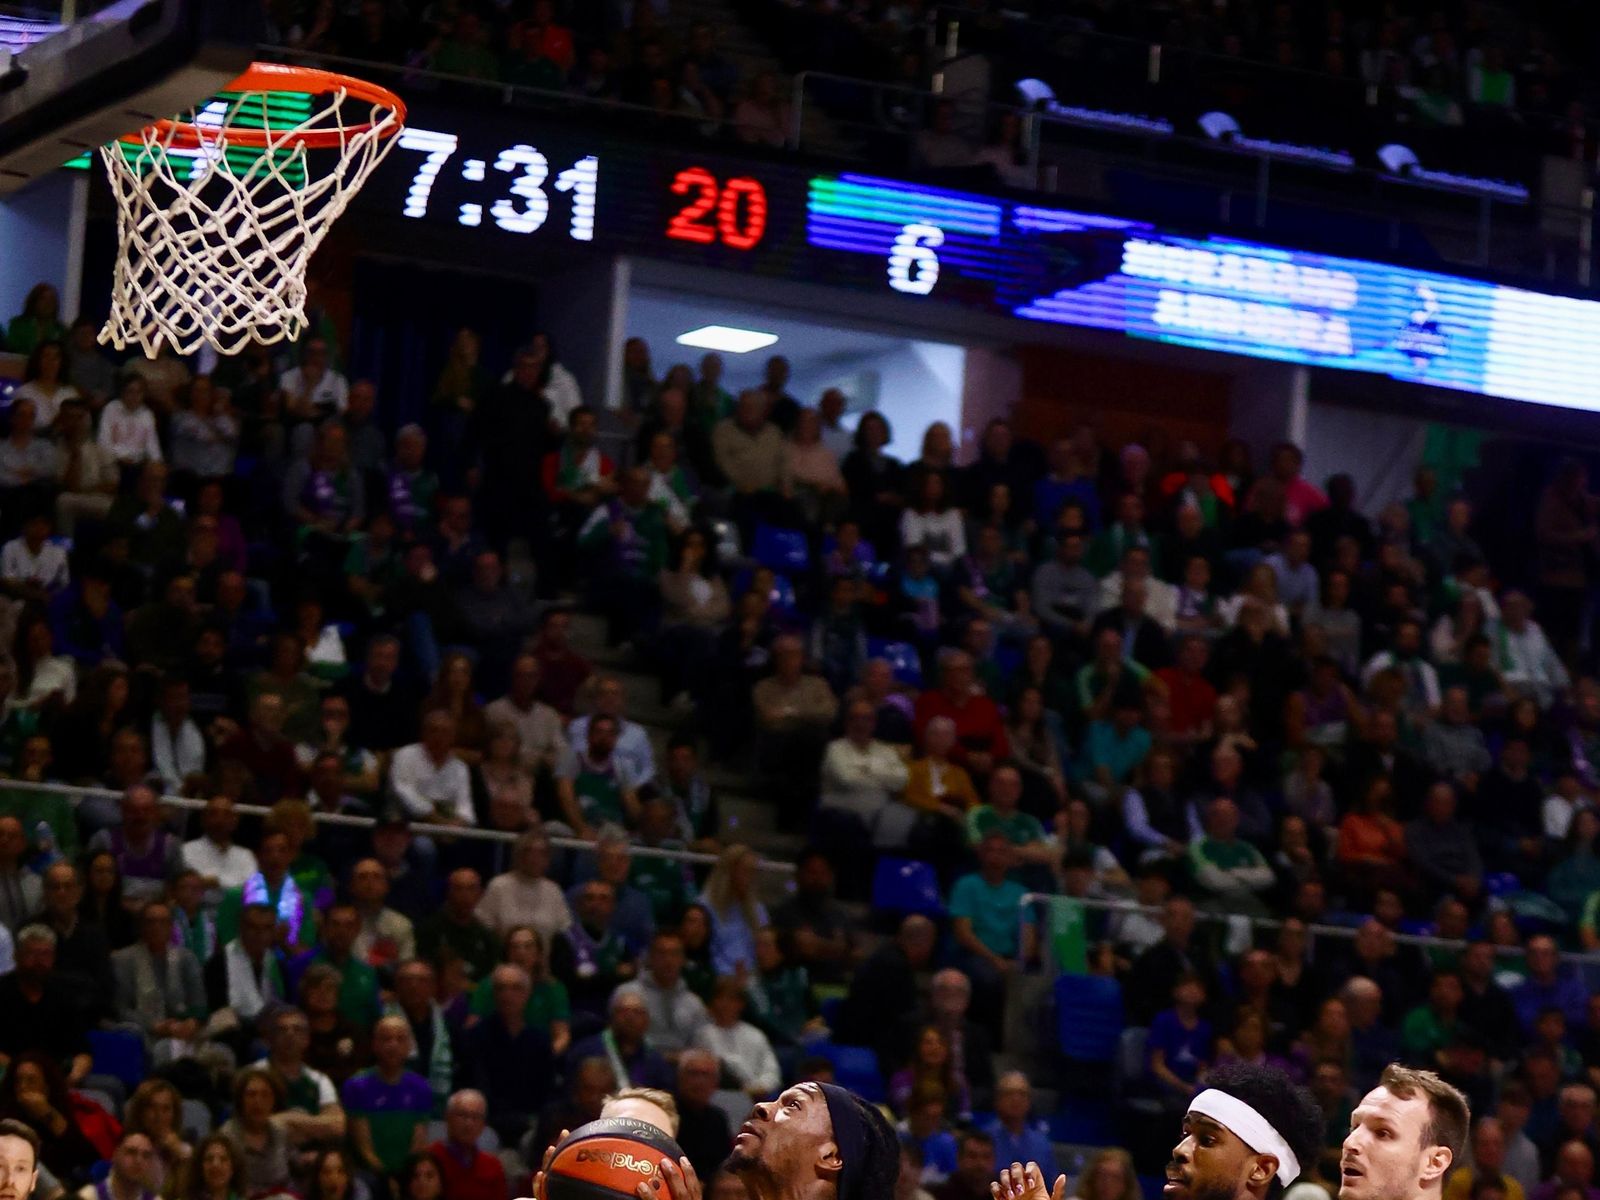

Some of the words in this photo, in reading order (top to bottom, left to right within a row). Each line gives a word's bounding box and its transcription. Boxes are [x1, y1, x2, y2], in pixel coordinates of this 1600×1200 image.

[400, 127, 599, 241] 7:31
[666, 166, 768, 251] 20
[887, 220, 944, 296] 6
